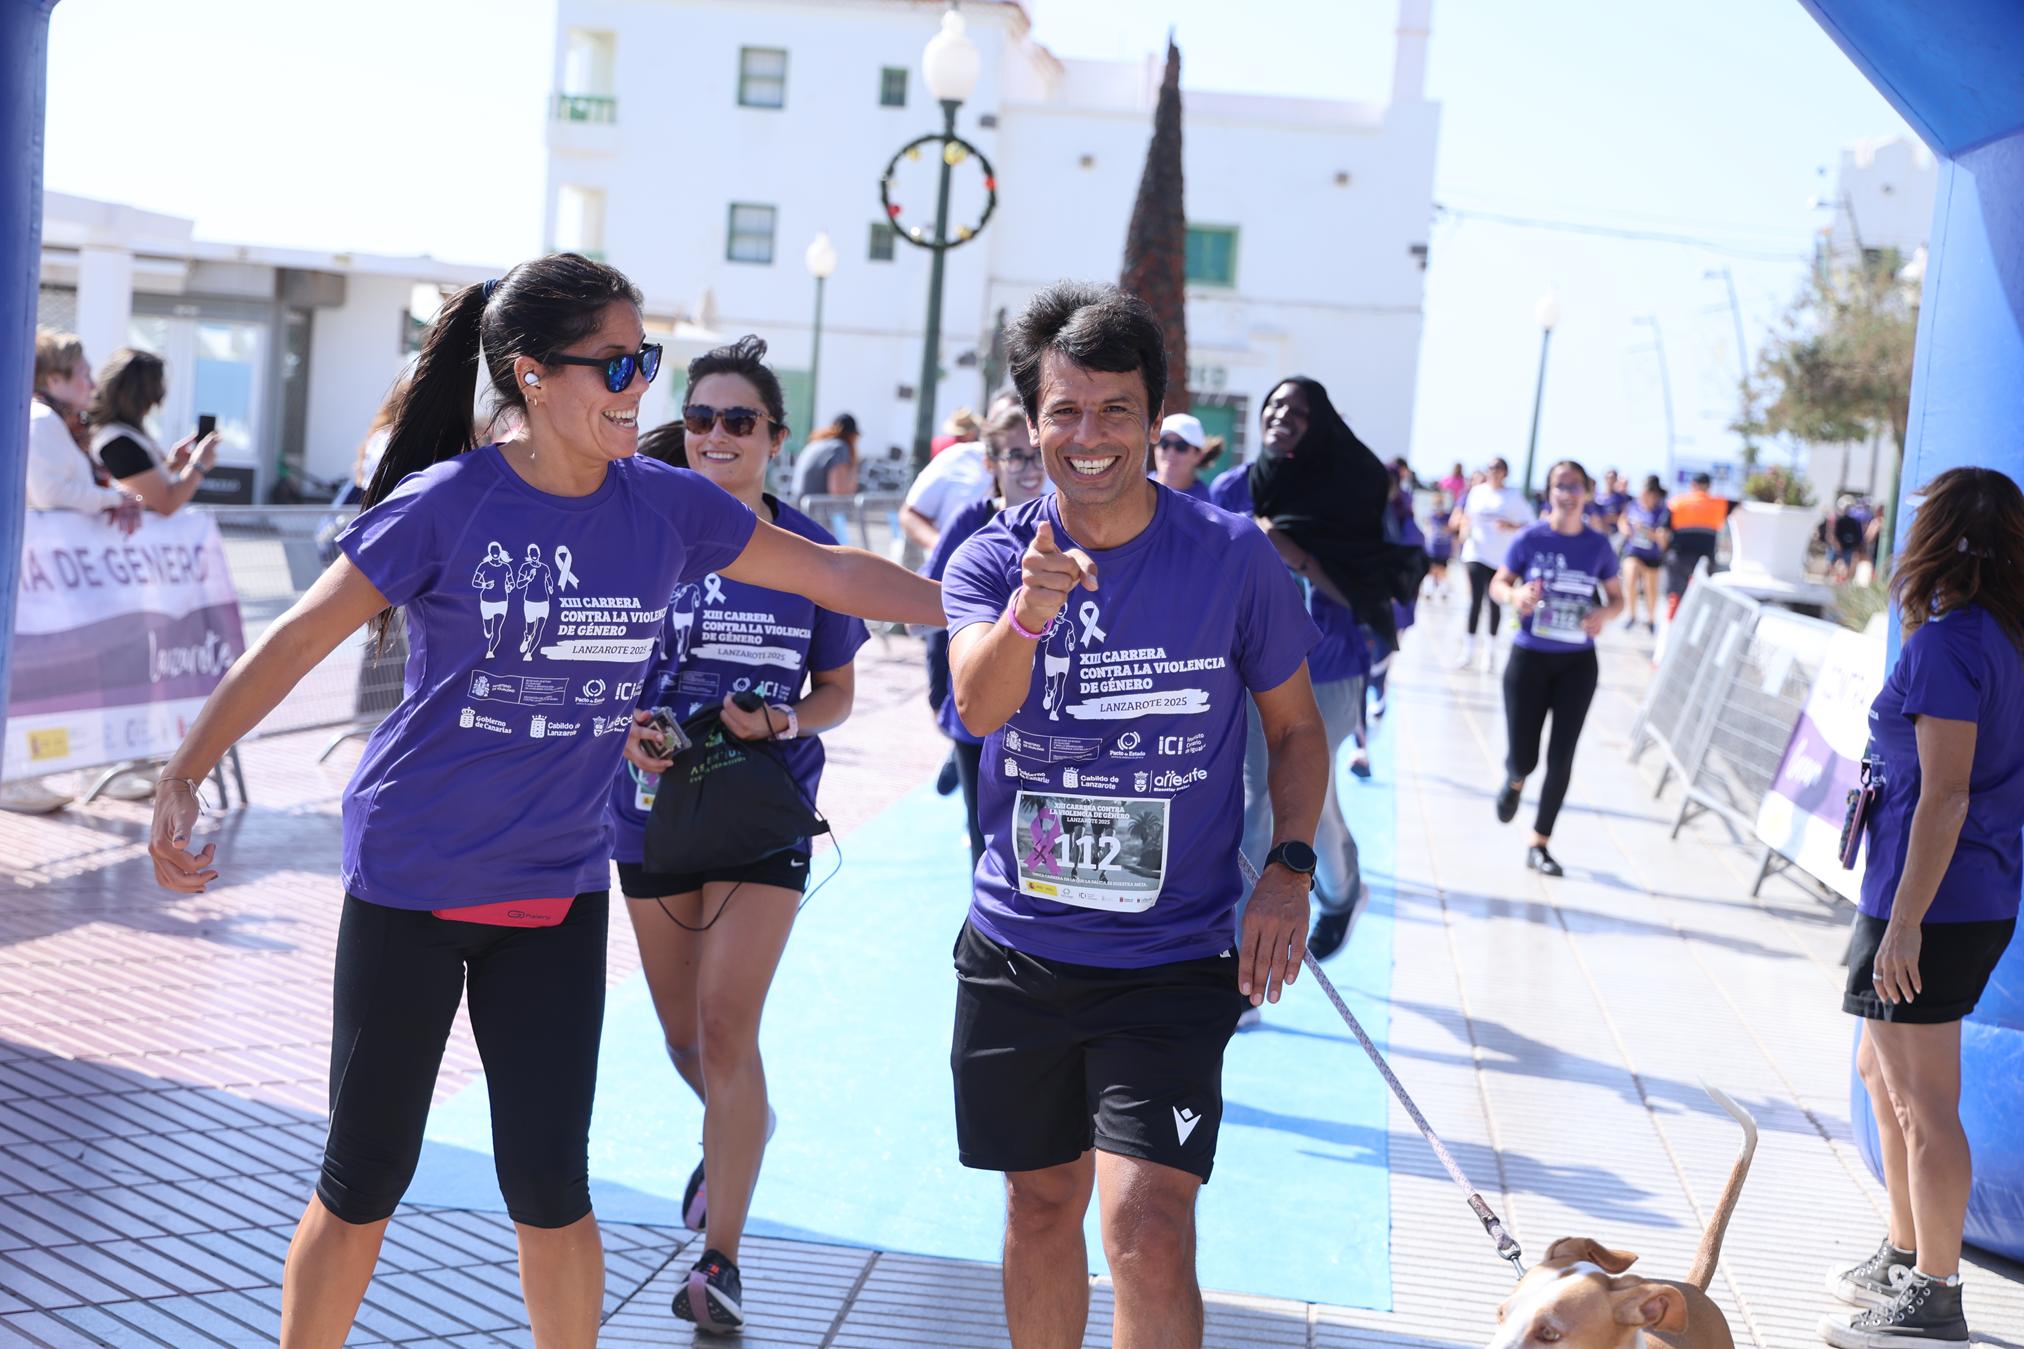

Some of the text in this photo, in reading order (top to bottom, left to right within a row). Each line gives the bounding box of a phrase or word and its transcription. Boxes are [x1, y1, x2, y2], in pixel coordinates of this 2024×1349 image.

[53, 549, 103, 589] DE
[560, 598, 641, 608] XIII CARRERA
[561, 611, 611, 622] CONTRA
[613, 612, 628, 622] LA
[703, 610, 775, 623] XIII CARRERA
[558, 623, 627, 636] DE GÉNERO
[703, 621, 748, 633] CONTRA
[749, 623, 763, 634] LA
[702, 632, 763, 645] DE GÉNERO
[573, 646, 629, 654] LANZAROTE
[1079, 648, 1166, 664] XIII CARRERA
[1080, 657, 1226, 680] CONTRA LA VIOLENCIA
[1080, 677, 1153, 694] DE GÉNERO
[1100, 697, 1188, 712] LANZAROTE 2025
[475, 716, 506, 726] Gobierno
[483, 723, 512, 734] Canarias
[1081, 781, 1116, 789] Lanzarote
[1054, 833, 1122, 870] 112
